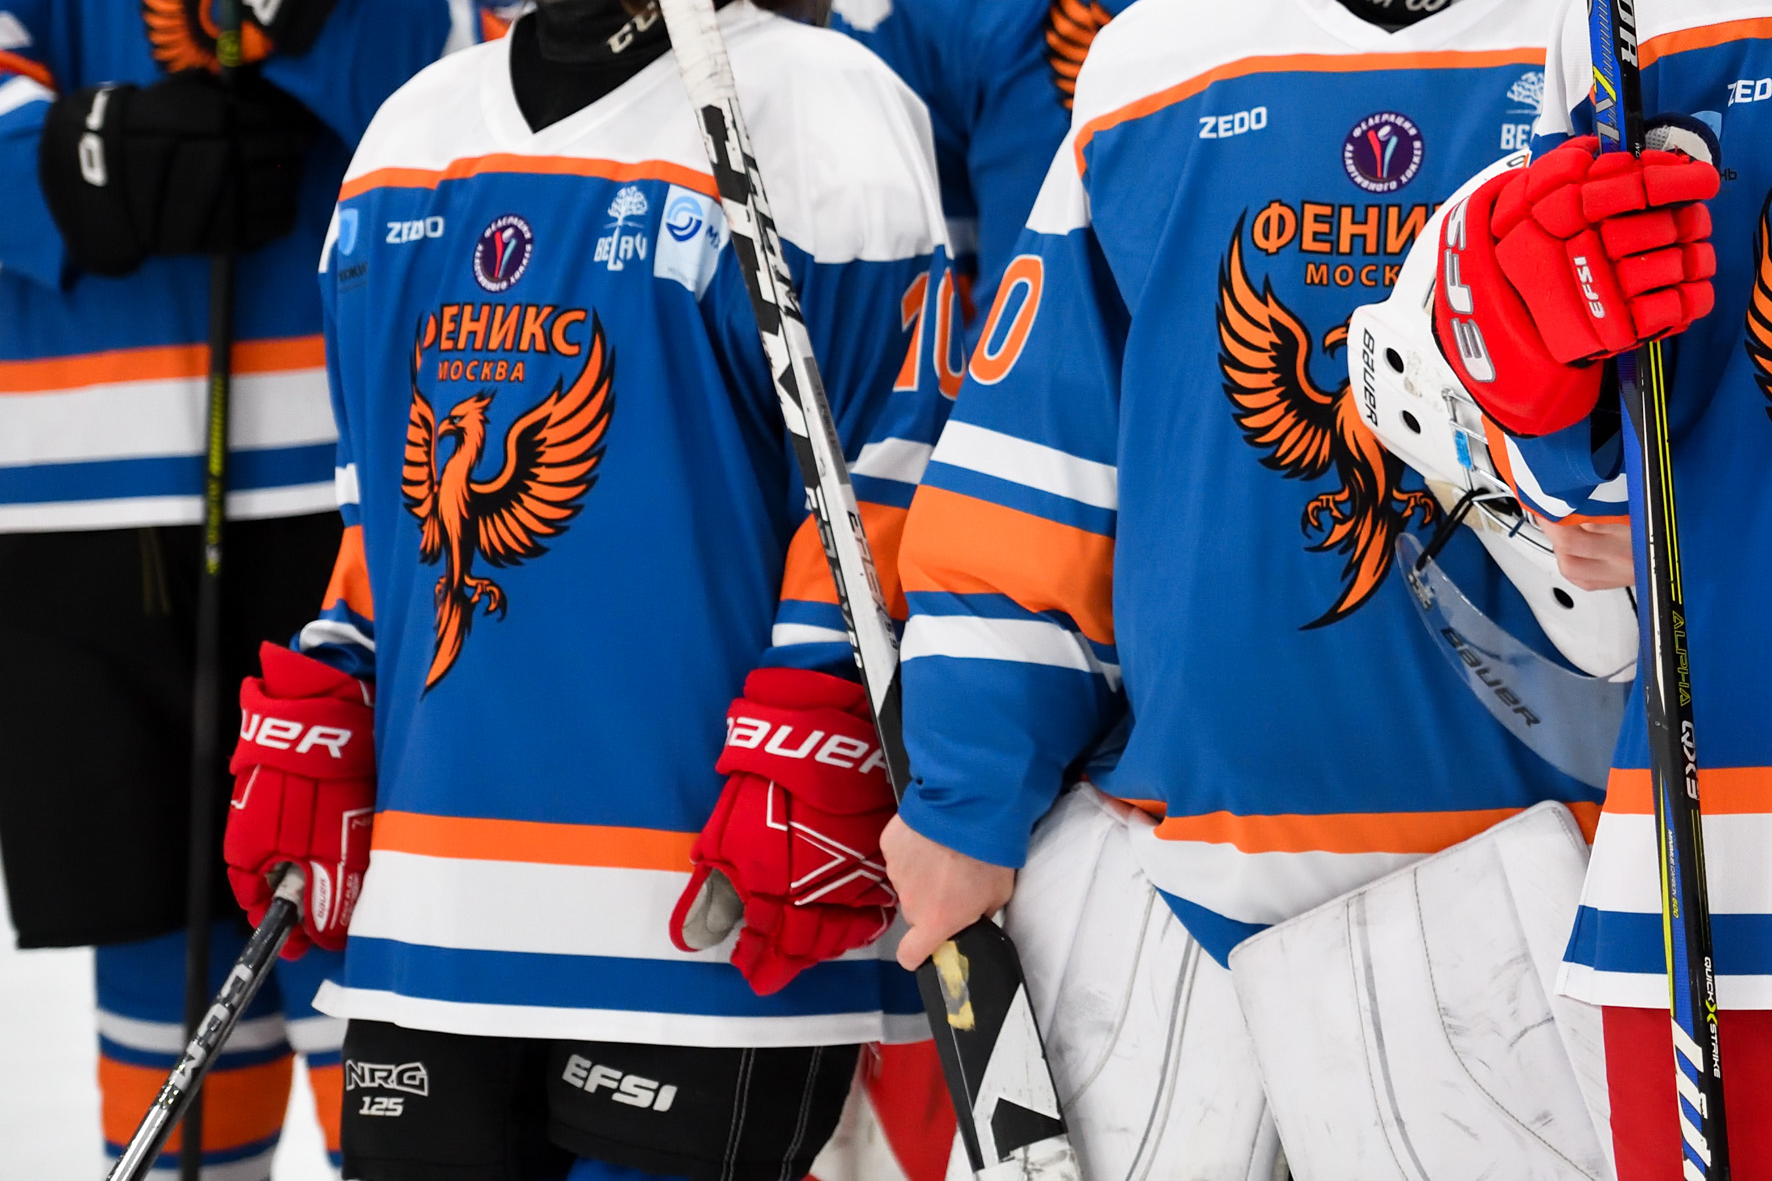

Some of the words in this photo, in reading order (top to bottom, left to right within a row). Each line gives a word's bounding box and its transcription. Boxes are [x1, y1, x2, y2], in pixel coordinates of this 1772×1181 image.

[1199, 106, 1268, 139] ZEDO
[1252, 198, 1446, 257] ФЕНИ
[1573, 256, 1606, 319] EFSI
[1361, 327, 1379, 427] BAUER
[1441, 627, 1541, 727] BAUER
[1672, 611, 1691, 707] ALPHA
[727, 717, 892, 785] AUE
[346, 1059, 429, 1097] NRG
[359, 1096, 405, 1117] 125
[562, 1053, 677, 1112] EFSI
